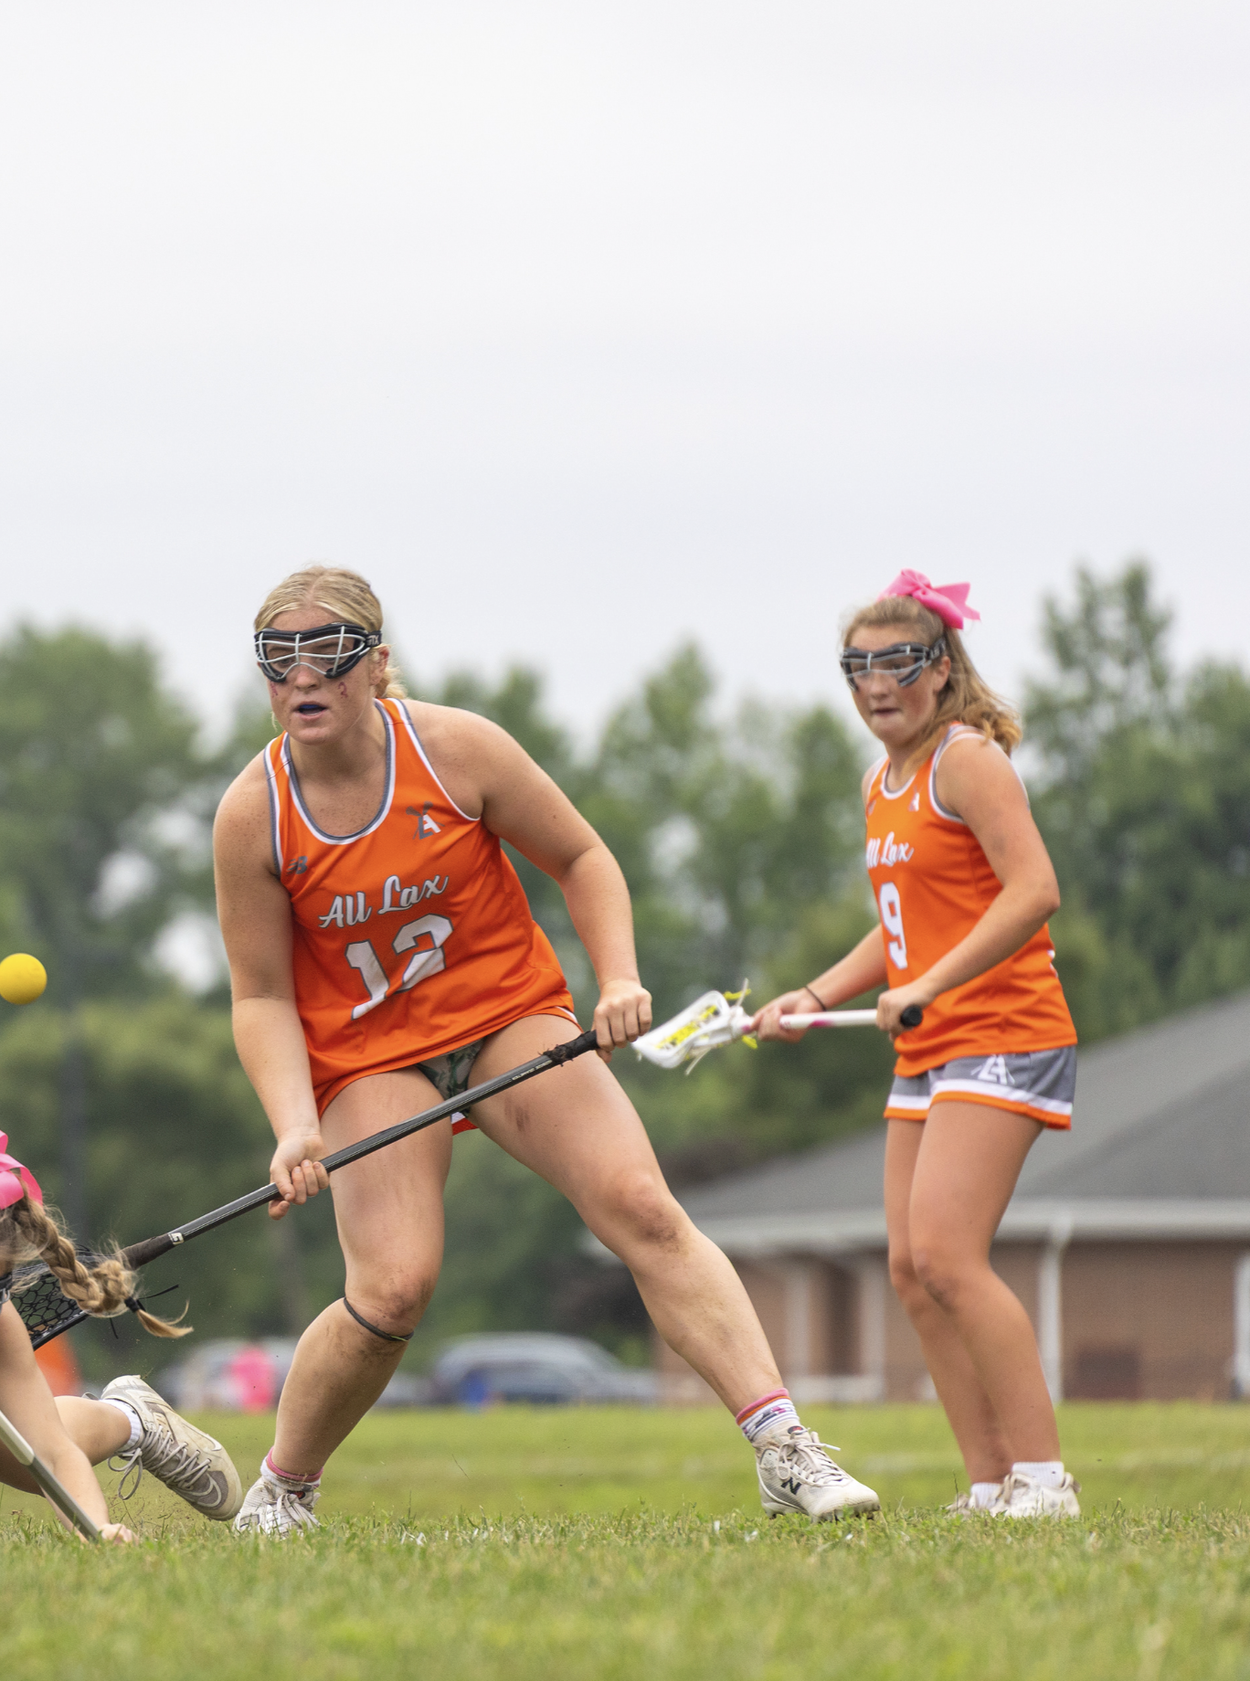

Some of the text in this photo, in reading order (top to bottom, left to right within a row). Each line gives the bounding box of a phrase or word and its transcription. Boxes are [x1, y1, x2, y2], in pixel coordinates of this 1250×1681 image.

[881, 831, 915, 868] Lax
[319, 875, 450, 929] All Lax
[879, 881, 908, 970] 9
[344, 913, 454, 1021] 12
